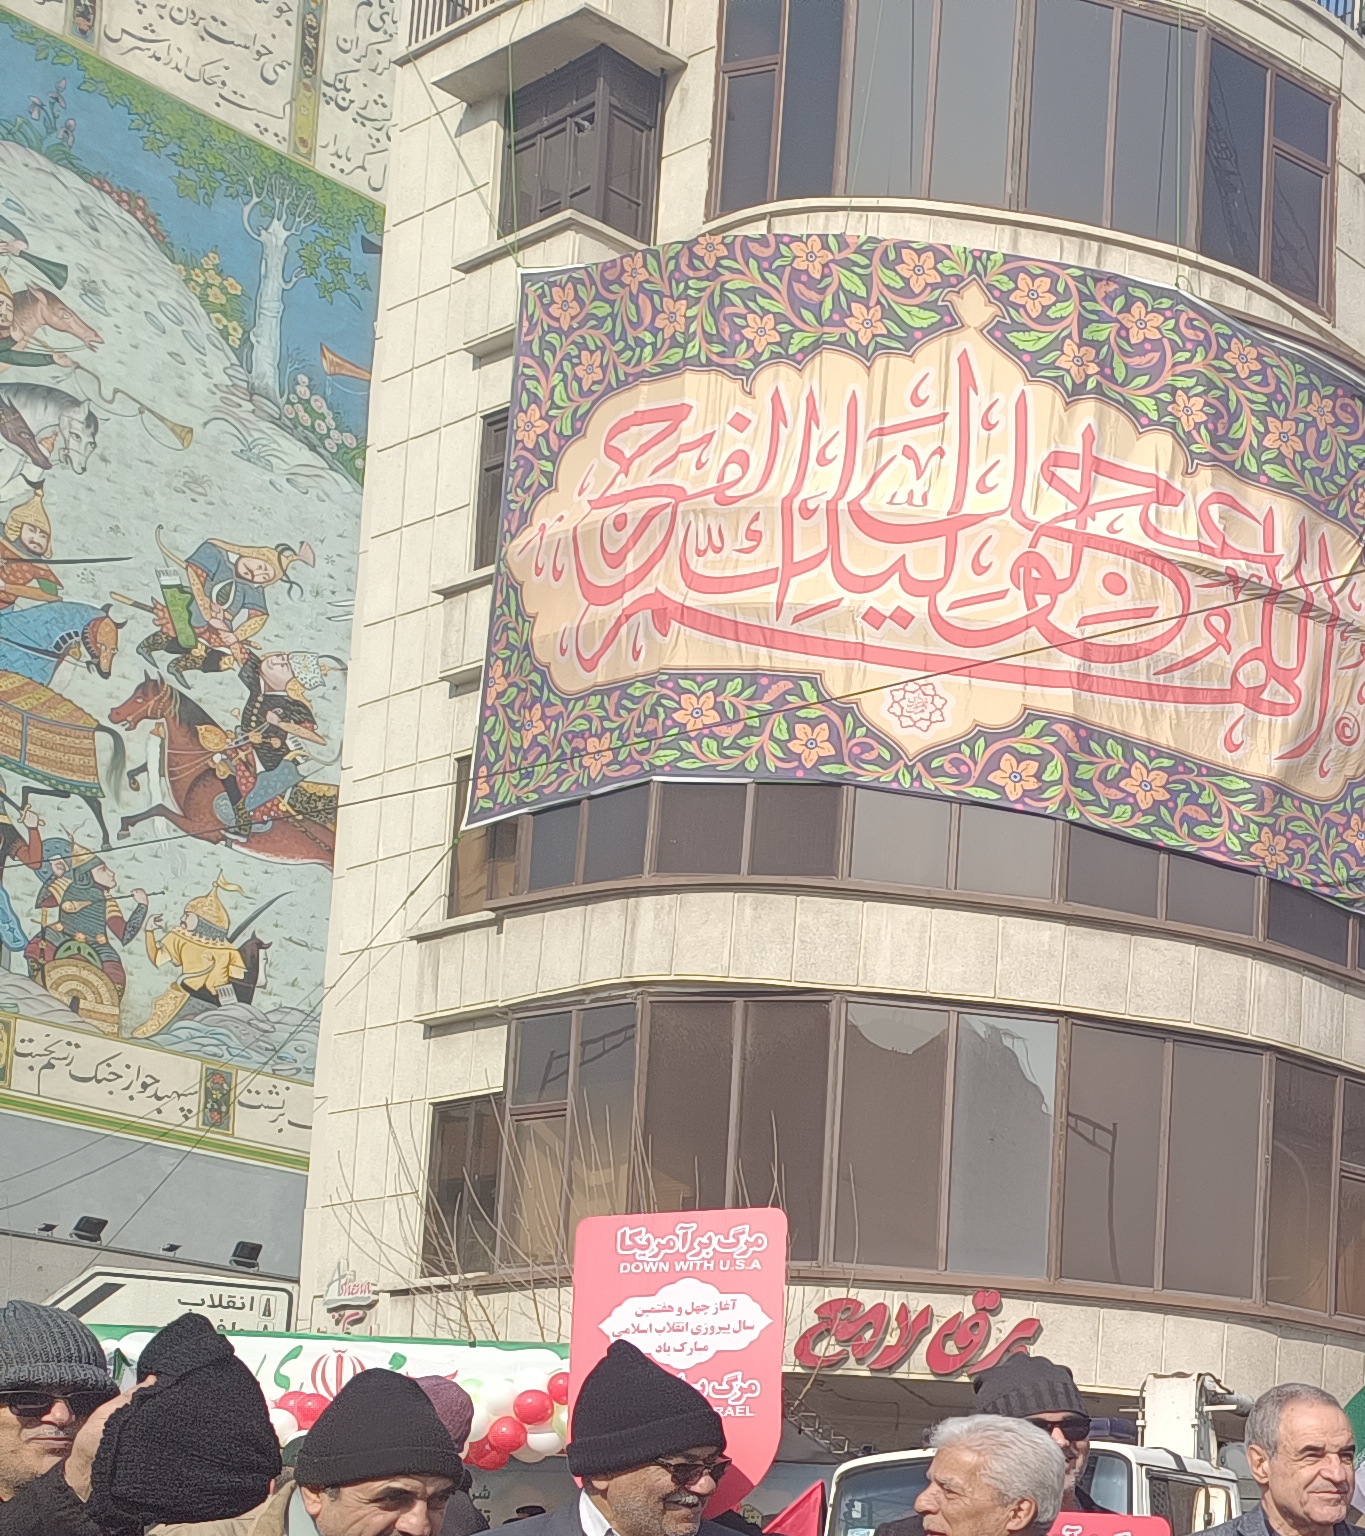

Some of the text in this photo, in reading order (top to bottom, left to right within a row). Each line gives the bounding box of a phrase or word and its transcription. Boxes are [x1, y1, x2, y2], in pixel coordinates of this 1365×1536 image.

[616, 1223, 699, 1261] آمریکا
[715, 1223, 768, 1259] مرگ
[619, 1258, 762, 1274] DOWN WITH U.S.A
[177, 1293, 255, 1314] انقلاب
[634, 1298, 738, 1318] آغاز چهل و هفتمین
[611, 1319, 756, 1339] سال پیروزی انقلاب اسلامی
[654, 1341, 710, 1357] مبارک باد
[713, 1405, 757, 1418] RAEL
